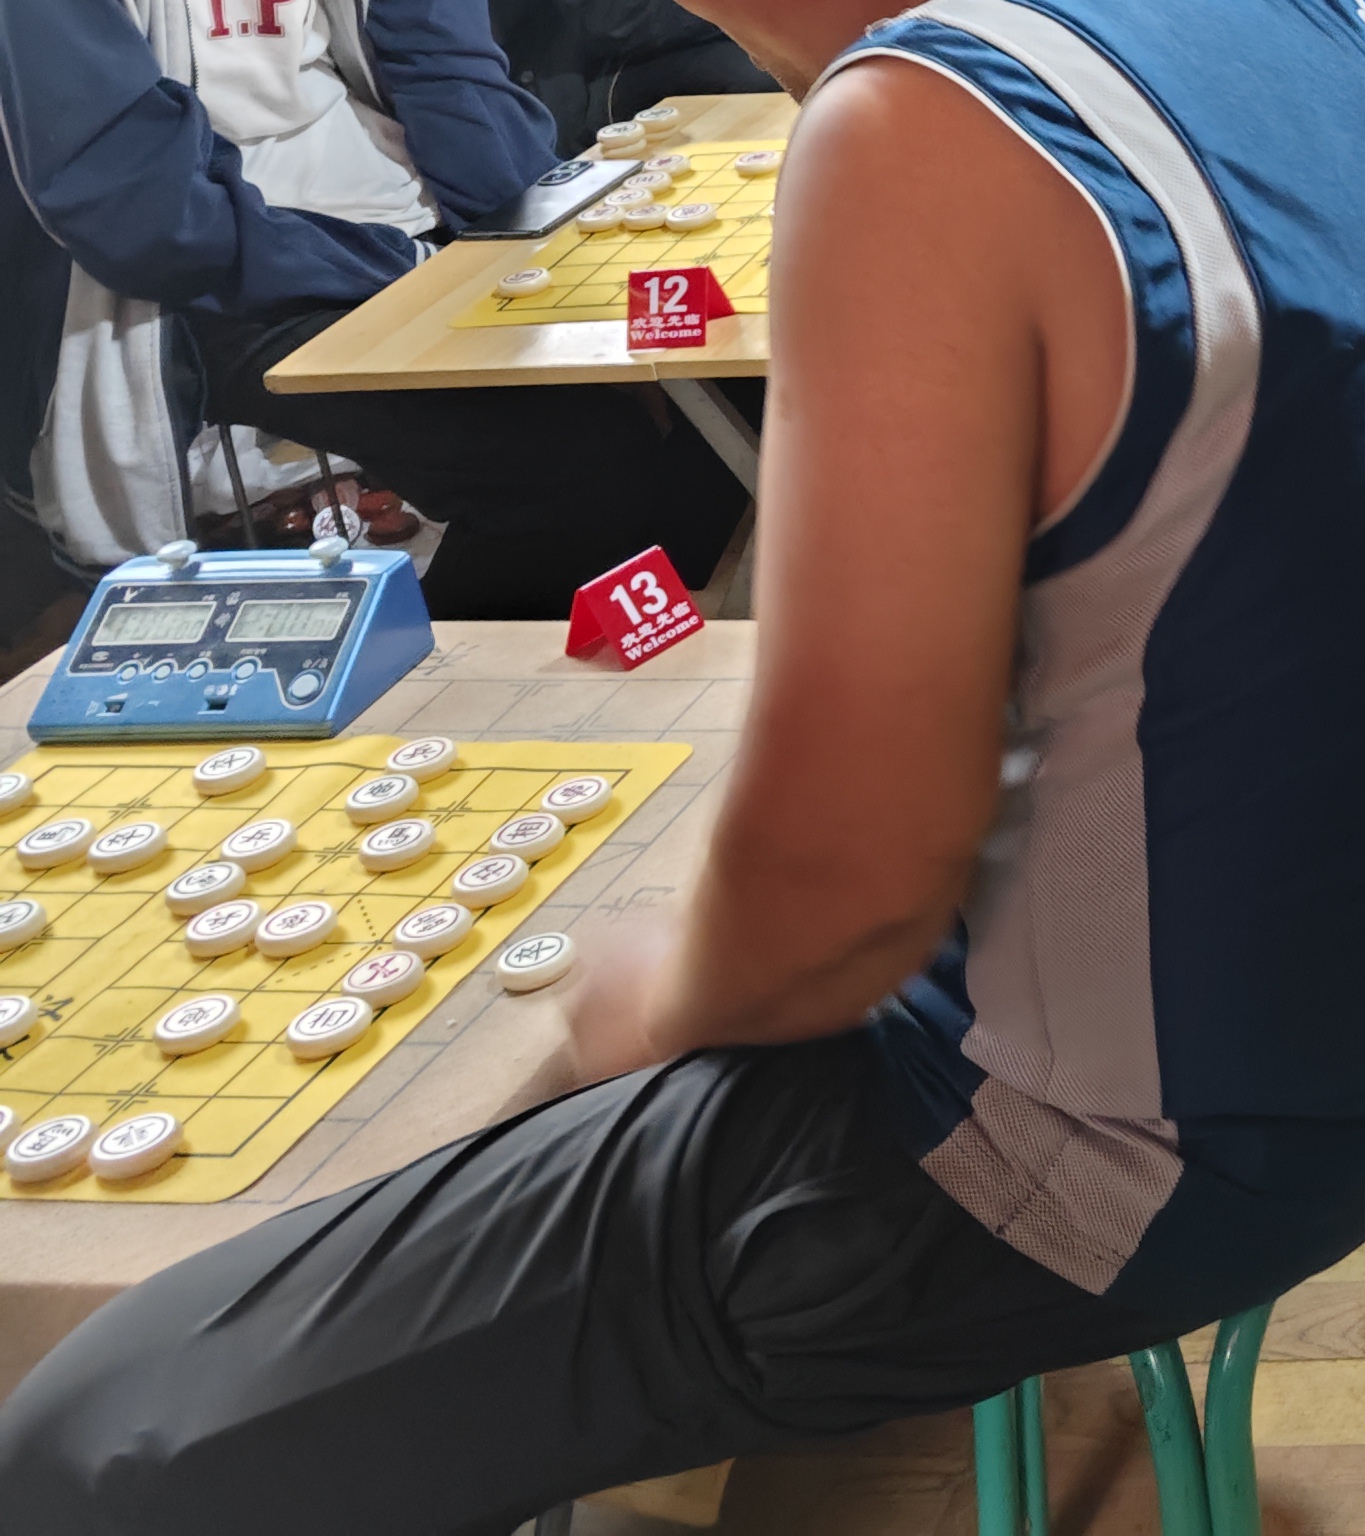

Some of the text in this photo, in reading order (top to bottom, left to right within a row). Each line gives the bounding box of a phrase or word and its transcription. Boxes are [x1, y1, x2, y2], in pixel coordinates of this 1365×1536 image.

[644, 275, 689, 314] 12
[630, 328, 702, 341] Welcome
[631, 313, 701, 329] 欢迎光临
[609, 570, 669, 626] 13
[621, 600, 691, 649] 欢迎光临
[625, 614, 699, 660] Welcome
